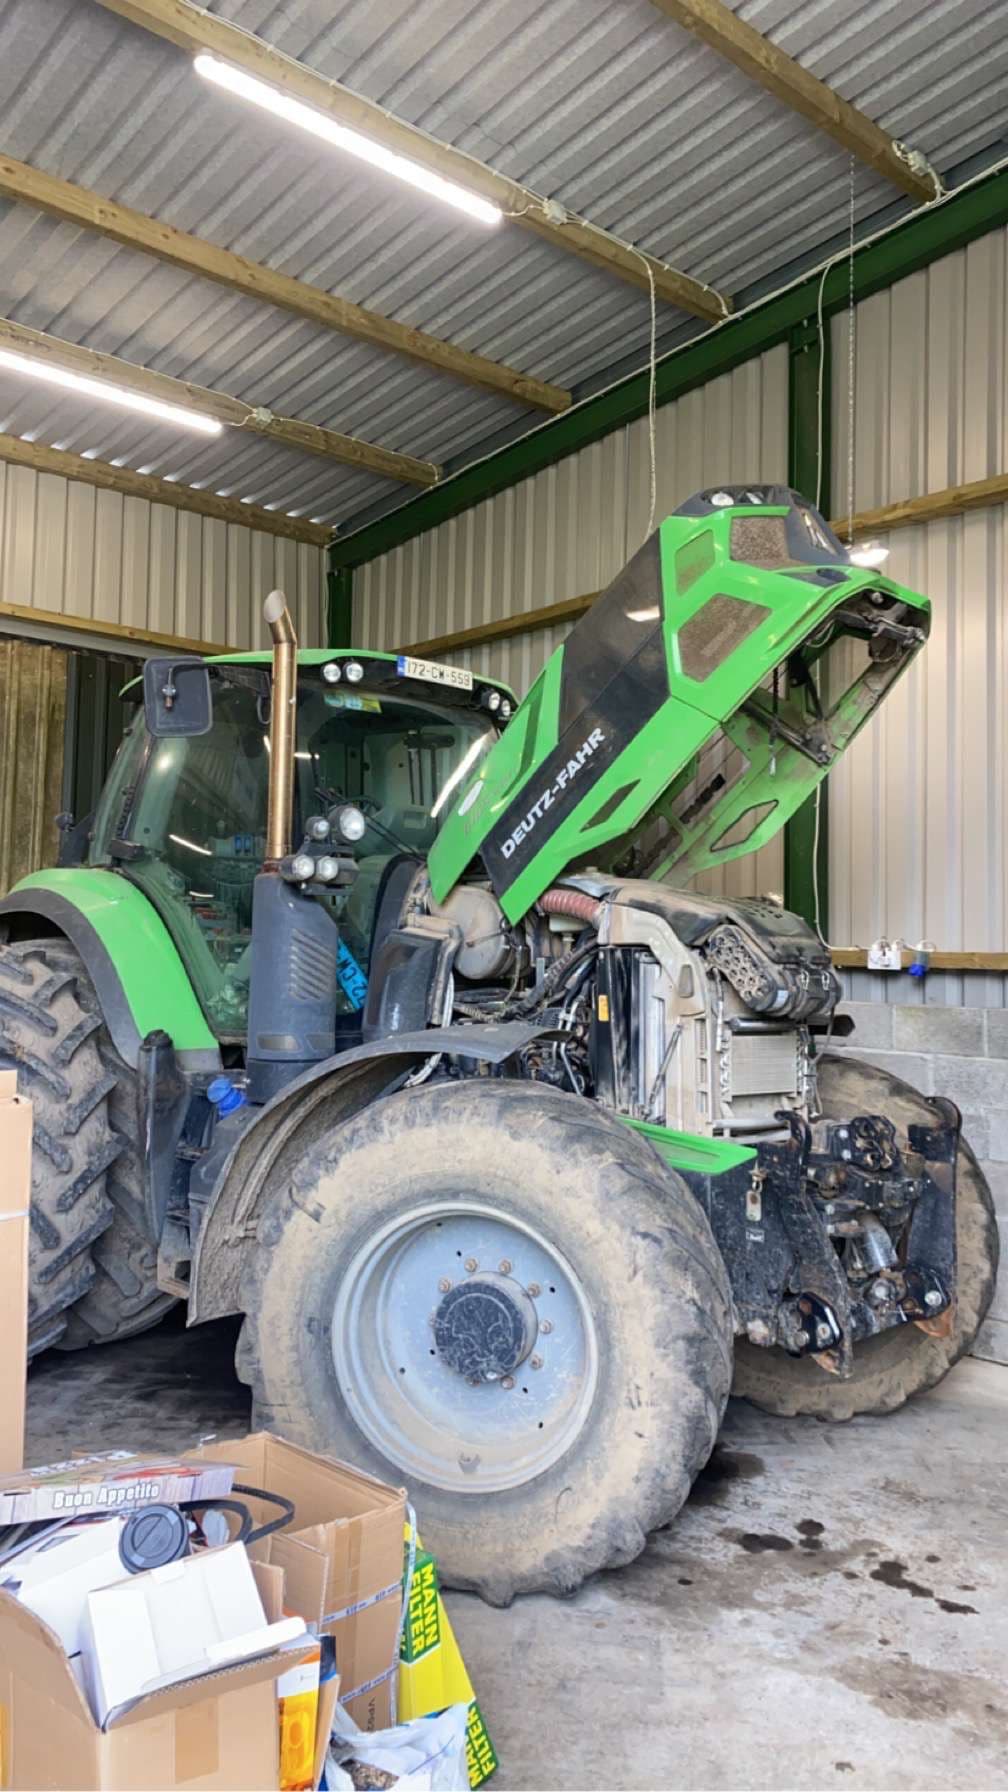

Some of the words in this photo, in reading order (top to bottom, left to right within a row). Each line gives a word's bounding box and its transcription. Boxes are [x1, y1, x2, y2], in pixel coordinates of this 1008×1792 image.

[500, 727, 605, 859] DEUTZ-FAHR
[53, 1491, 92, 1509] Buon
[98, 1483, 160, 1506] Appetito
[409, 1571, 425, 1658] FILTER
[420, 1562, 439, 1647] MANN
[467, 1706, 497, 1777] FILTER
